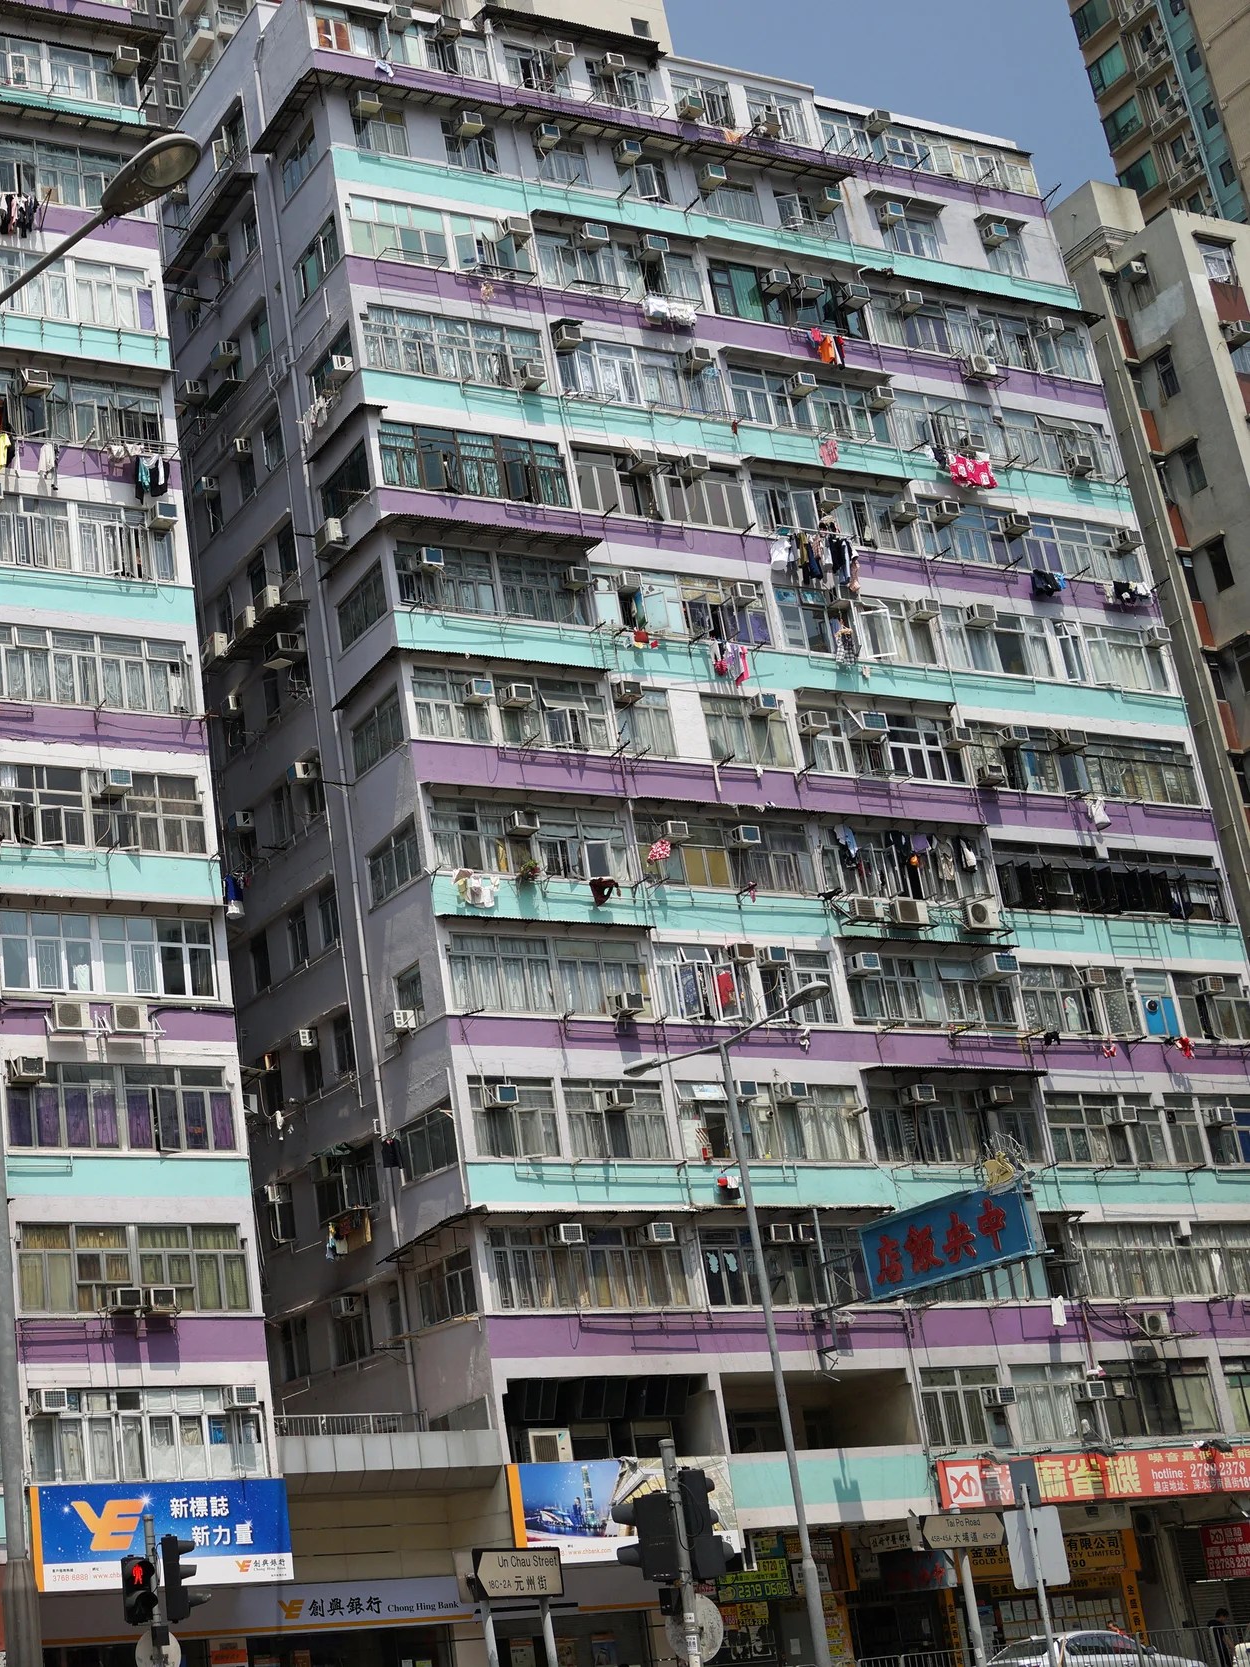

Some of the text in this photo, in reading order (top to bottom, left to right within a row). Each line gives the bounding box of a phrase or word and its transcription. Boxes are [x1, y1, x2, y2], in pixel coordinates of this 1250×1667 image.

[981, 1456, 1141, 1498] 宣 麻雀機
[1151, 1461, 1246, 1480] hotline: 2788 2378
[985, 1489, 1015, 1501] TRY
[169, 1496, 230, 1519] 新標誌
[945, 1517, 981, 1528] Tai Po Road
[191, 1523, 254, 1546] 新力量
[953, 1532, 978, 1543] 大埔道
[1066, 1536, 1119, 1551] 有限公司
[497, 1555, 557, 1568] Un Chau Street
[972, 1558, 996, 1566] GOLD
[1087, 1549, 1120, 1558] LIMITED
[488, 1575, 547, 1591] 18C-2A 元州街
[764, 1581, 789, 1596] 0606
[308, 1596, 383, 1618] 創興銀行
[387, 1600, 459, 1614] Chong Hing Bank
